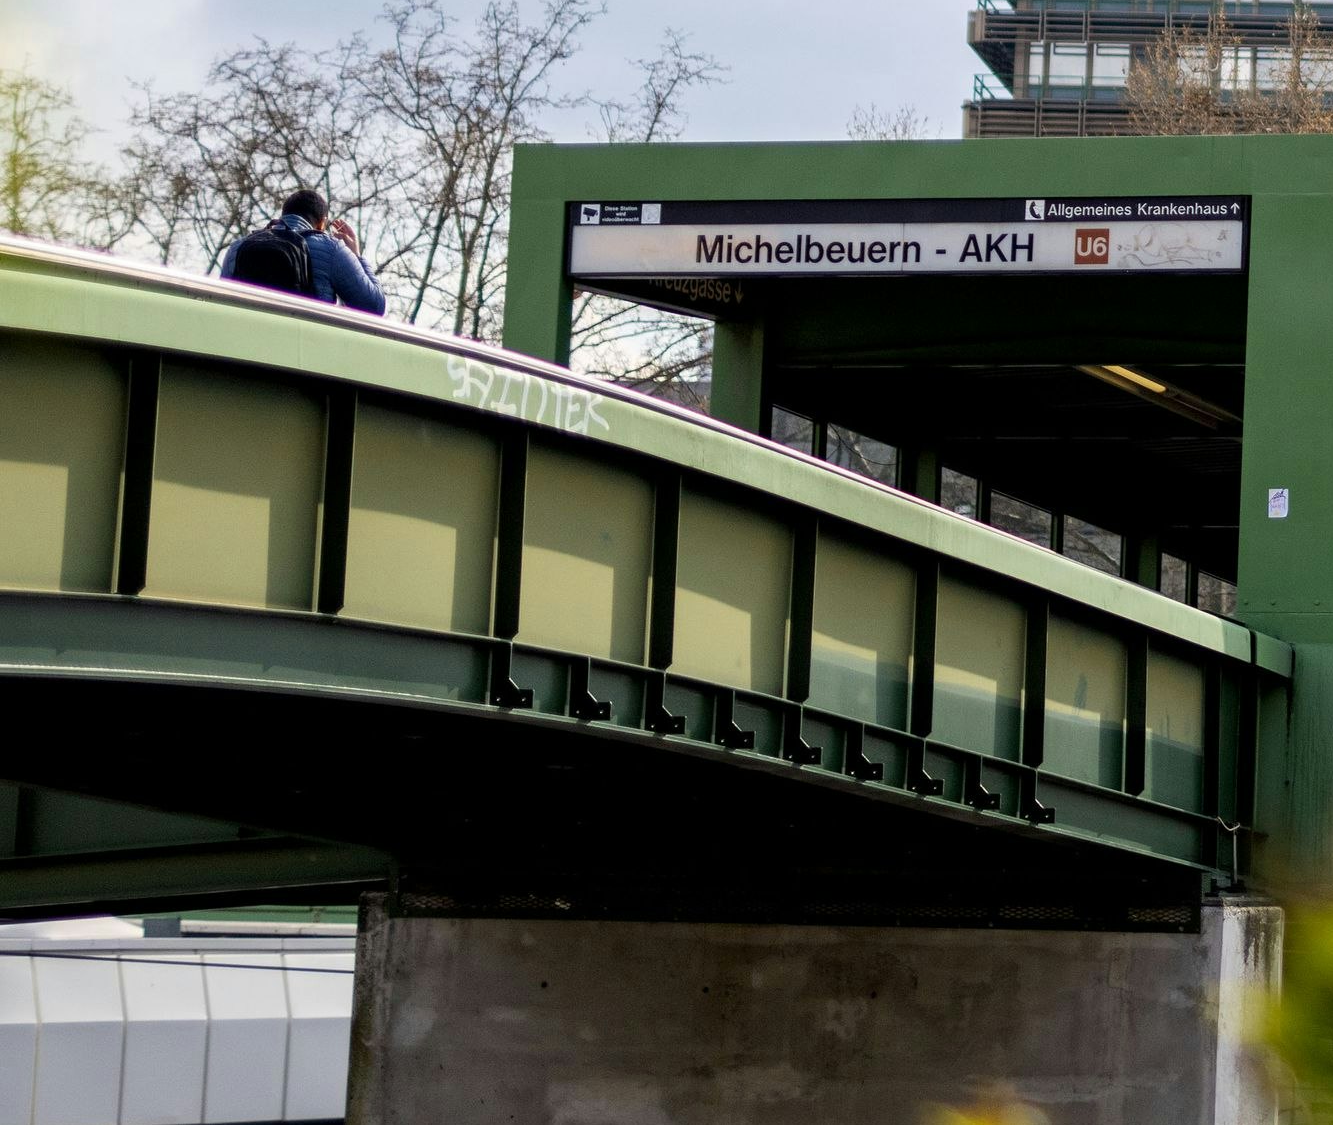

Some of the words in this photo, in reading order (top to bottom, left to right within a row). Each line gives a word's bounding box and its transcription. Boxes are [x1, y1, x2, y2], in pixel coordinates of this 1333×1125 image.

[1048, 202, 1132, 218] Allgemeines
[1137, 201, 1228, 216] Krankenhaus
[695, 233, 921, 264] Michelbeuern
[958, 233, 1035, 263] AKH
[1076, 236, 1108, 257] U6
